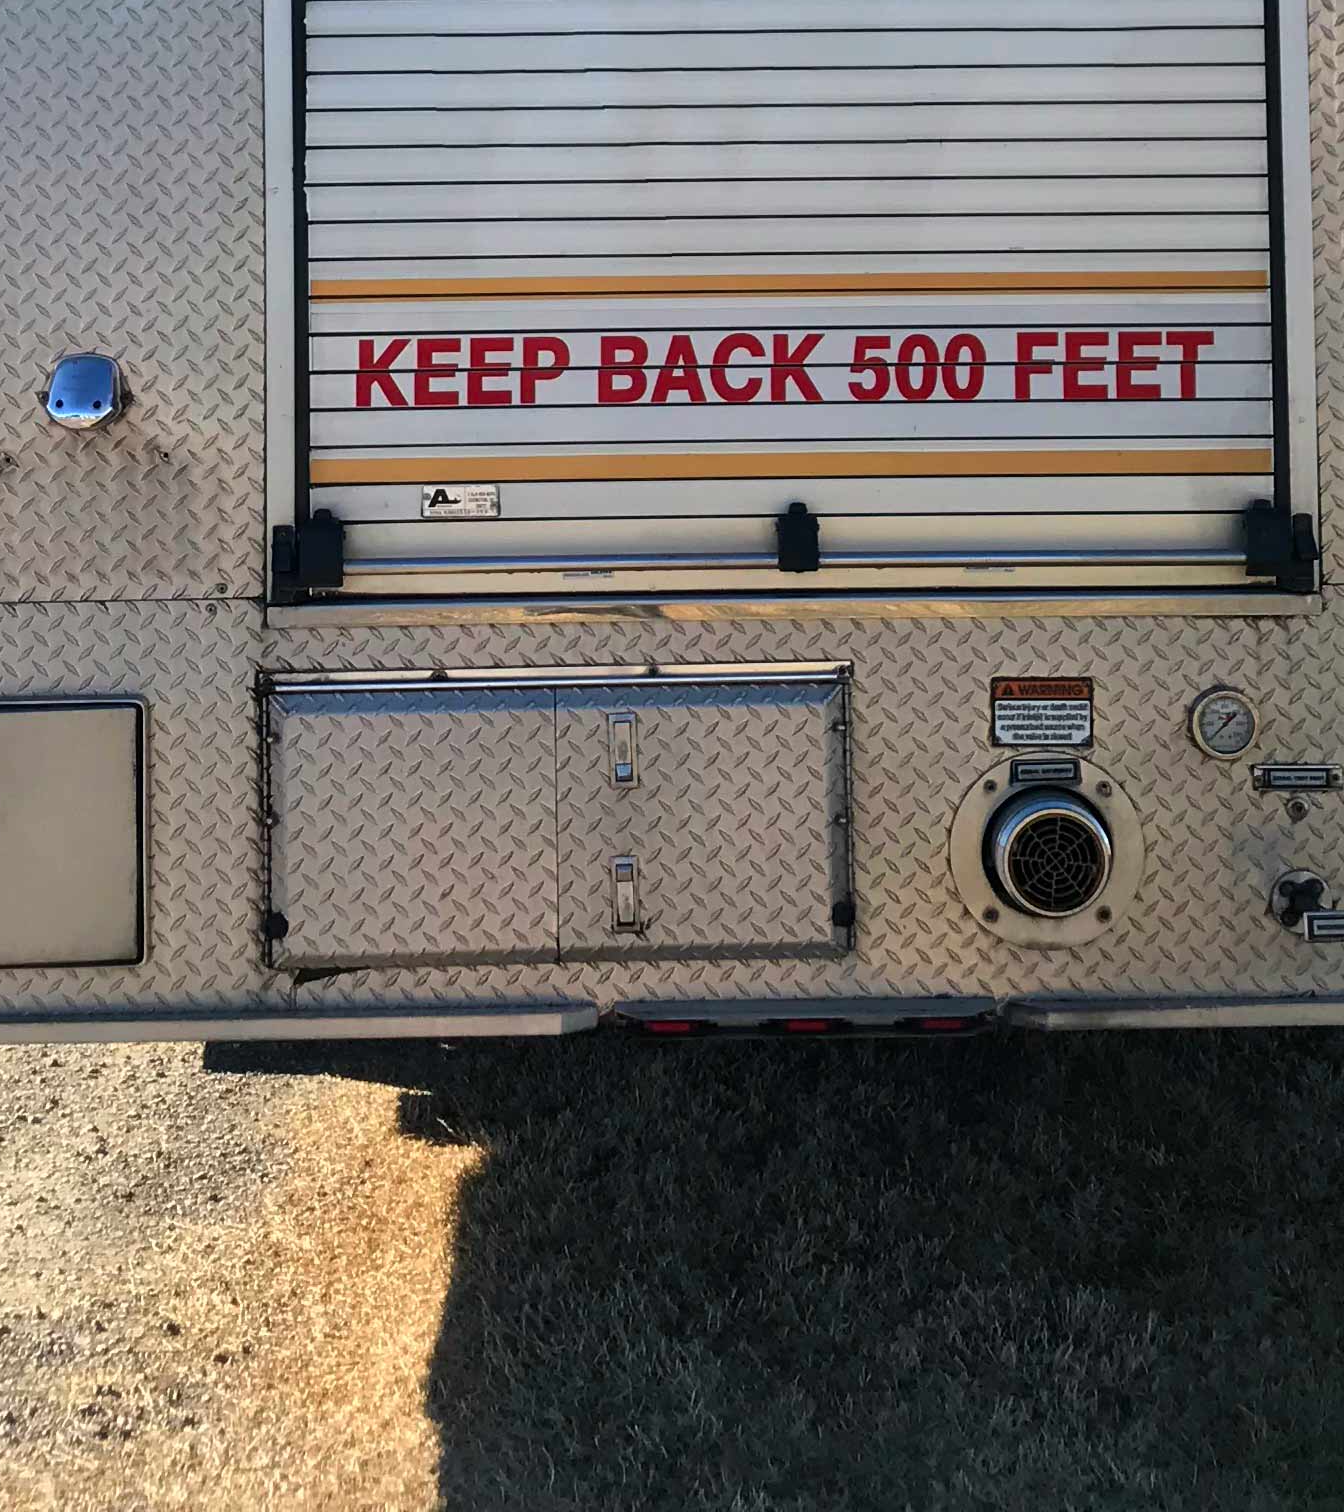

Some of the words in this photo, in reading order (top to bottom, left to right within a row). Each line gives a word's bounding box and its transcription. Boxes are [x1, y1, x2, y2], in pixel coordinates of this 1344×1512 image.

[356, 336, 570, 407] KEEP
[597, 333, 825, 404] BACK
[848, 333, 987, 402] 500
[1014, 330, 1214, 401] FEET
[1020, 684, 1085, 696] WARNING
